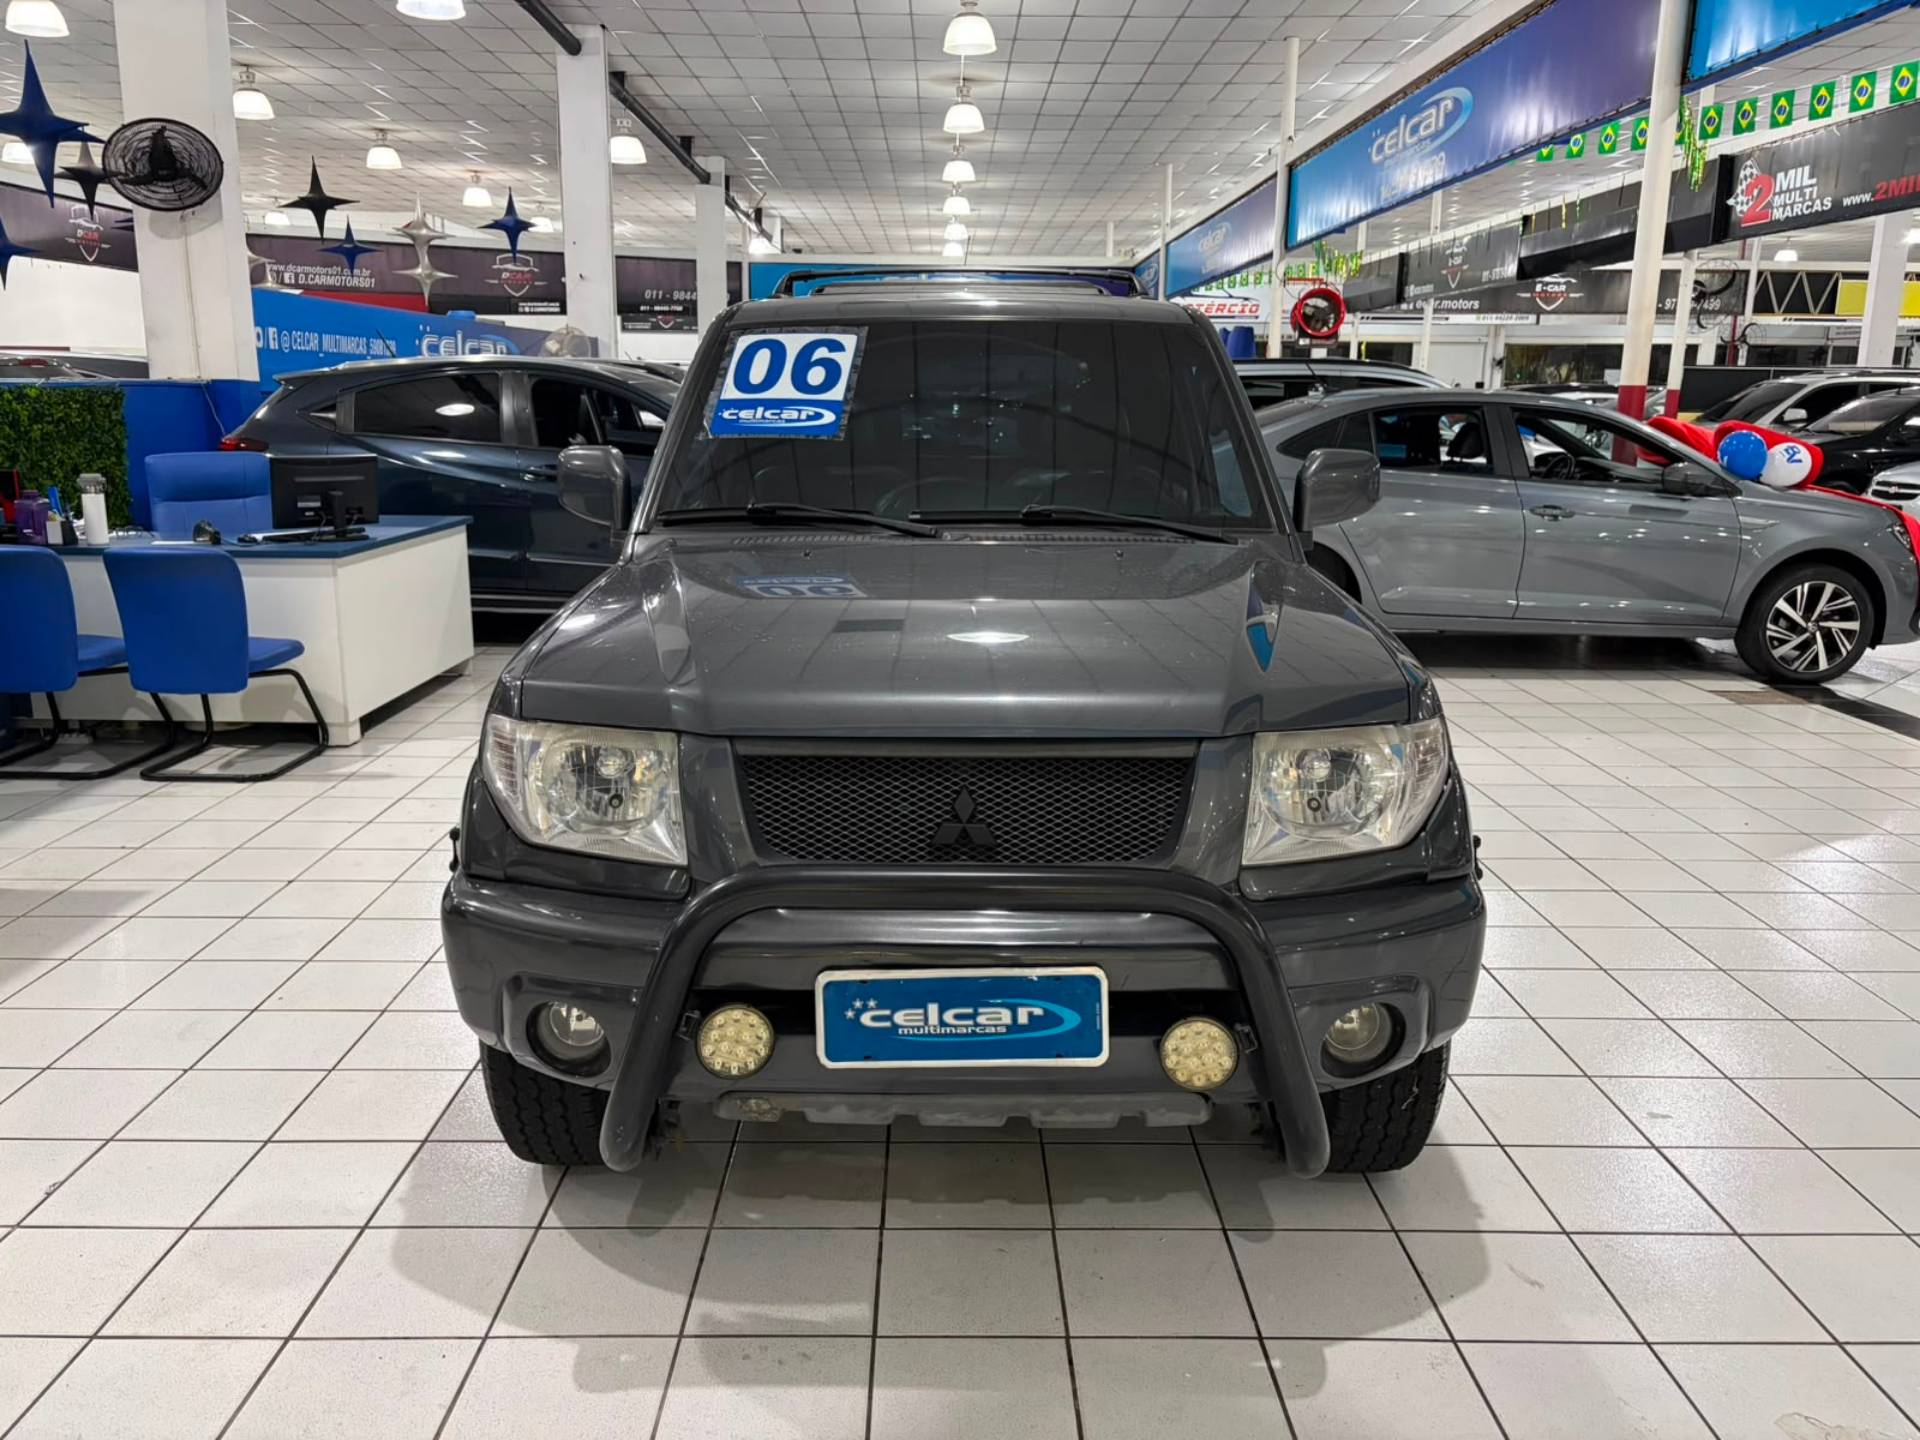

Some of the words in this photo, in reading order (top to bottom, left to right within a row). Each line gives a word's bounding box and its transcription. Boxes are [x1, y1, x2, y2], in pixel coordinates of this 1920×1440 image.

[1371, 97, 1454, 164] celcar
[1775, 165, 1817, 193] MIL
[1741, 173, 1776, 228] 2
[1773, 187, 1818, 207] MULTI
[1772, 197, 1833, 221] MARCAS
[298, 274, 375, 288] D.CARMOTORS01
[644, 289, 663, 300] 011
[1416, 299, 1480, 310] er.motors
[733, 338, 847, 395] 06
[722, 406, 816, 420] celcar
[859, 1003, 1044, 1027] celcar
[898, 1025, 1007, 1035] multimarcas
